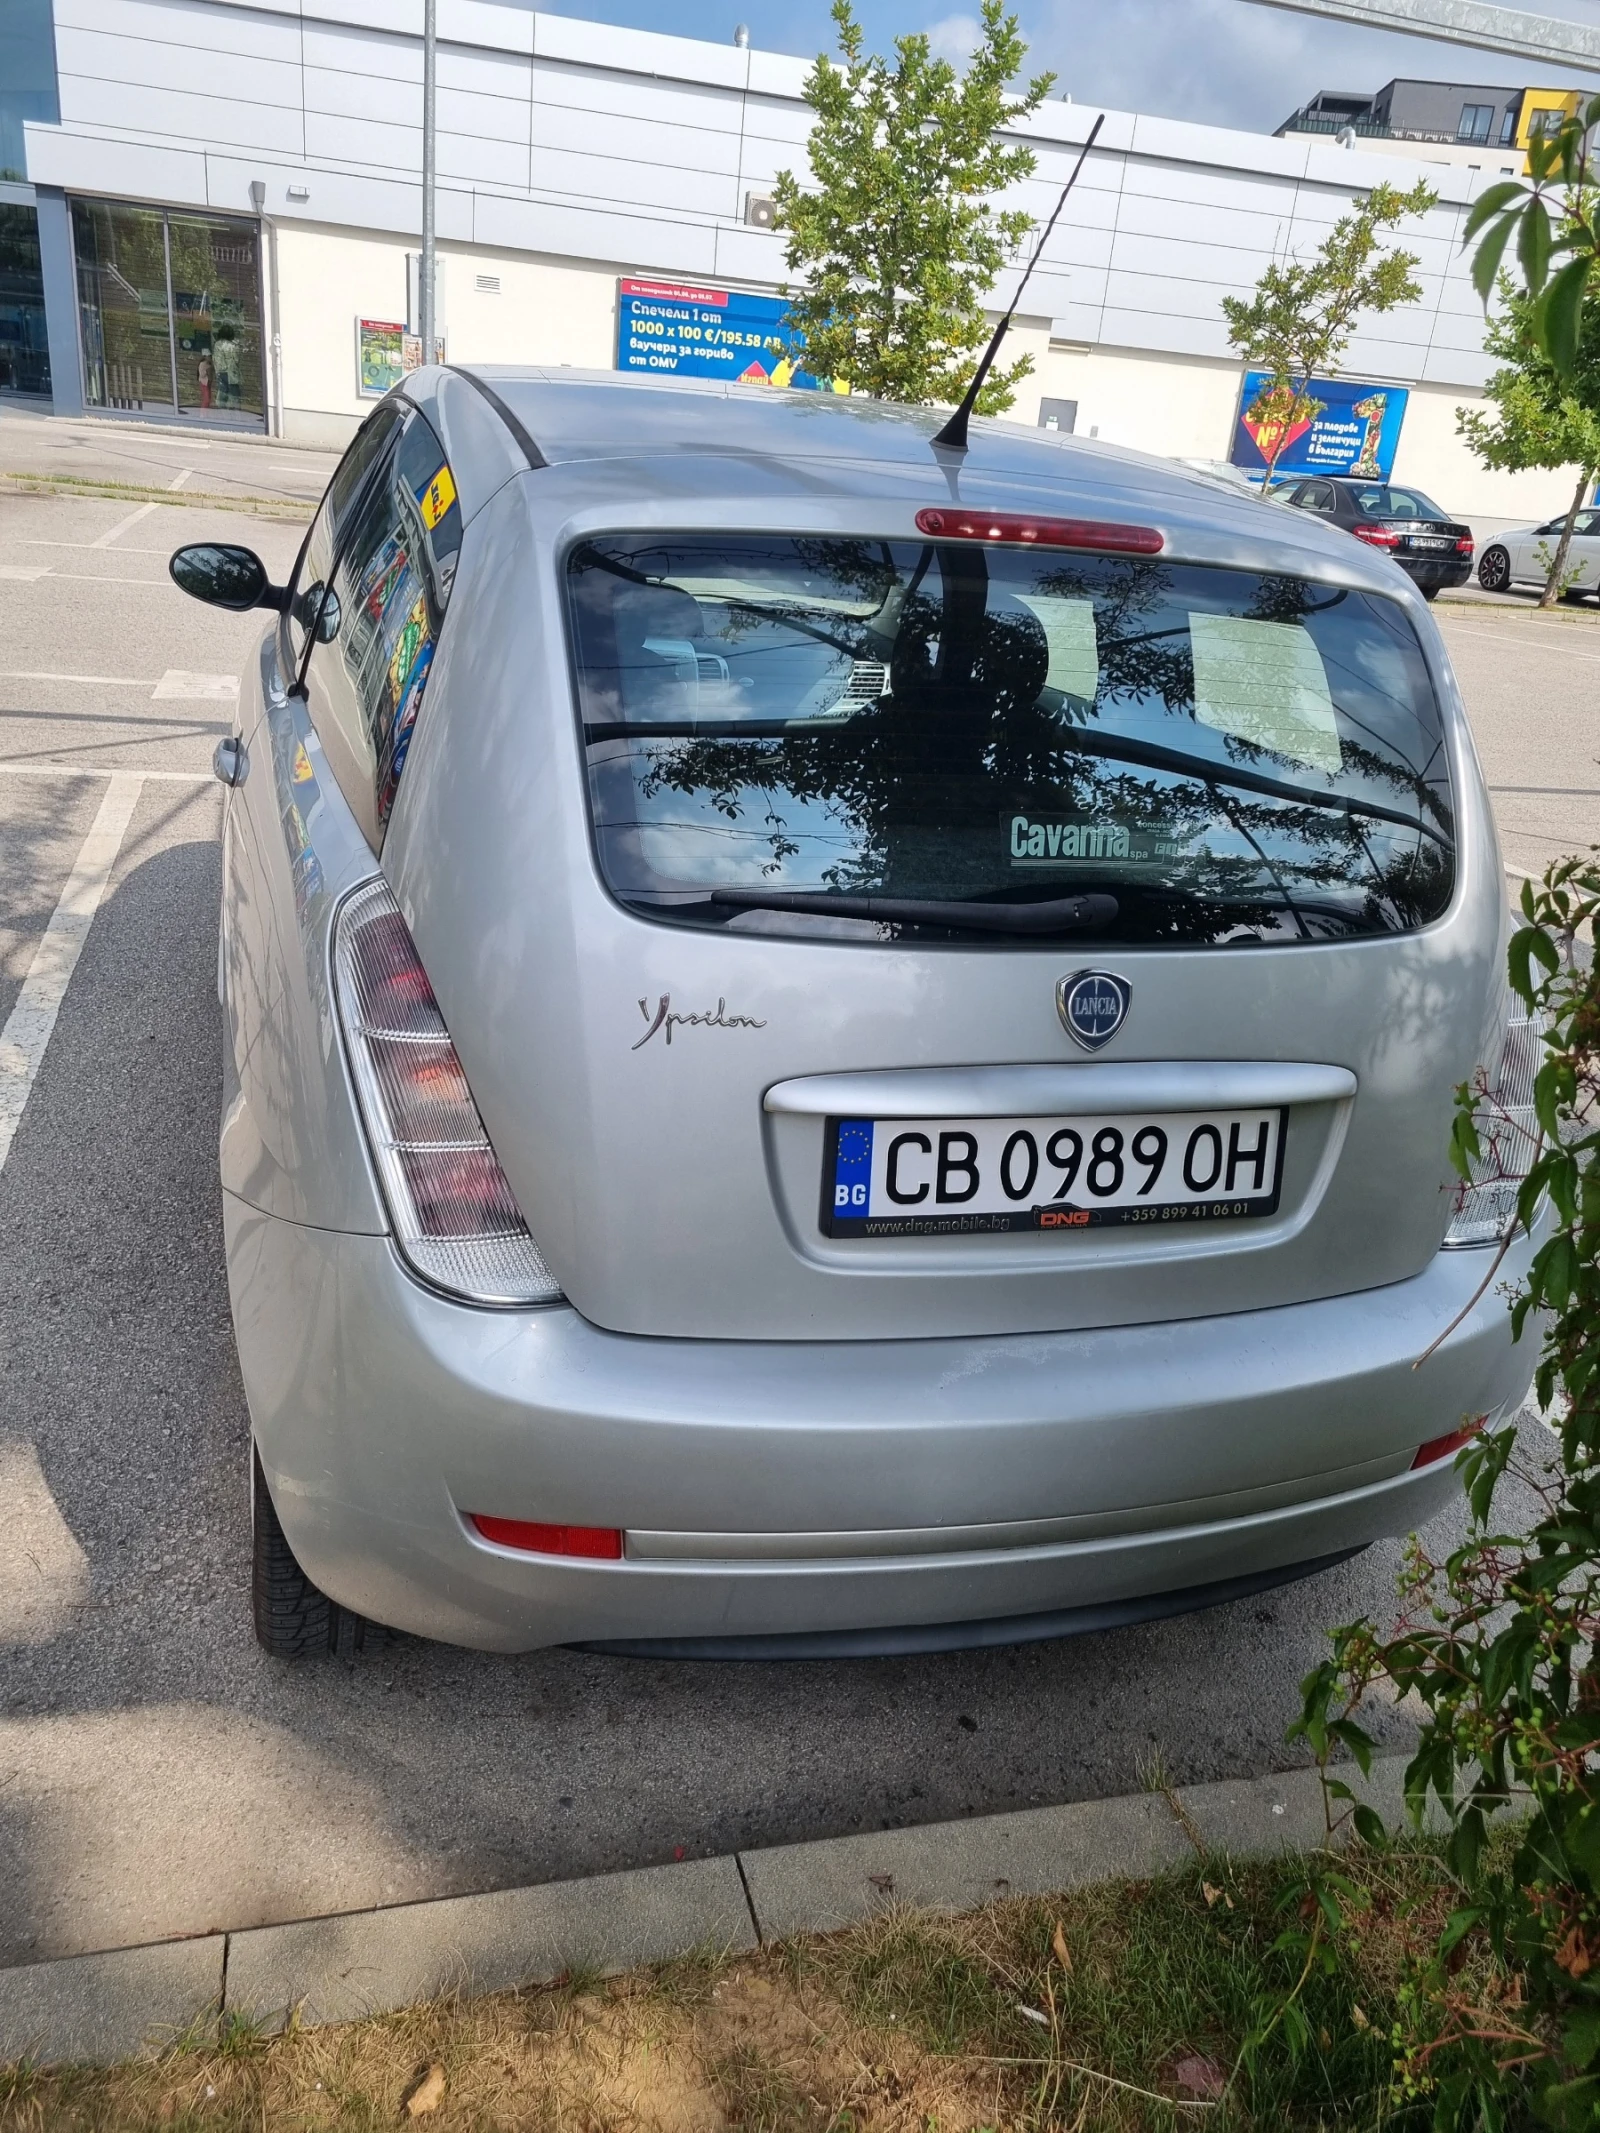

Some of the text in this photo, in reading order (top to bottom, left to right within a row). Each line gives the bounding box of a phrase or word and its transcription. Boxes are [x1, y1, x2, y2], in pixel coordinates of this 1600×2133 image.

[631, 301, 722, 324] Спечели 1 от
[630, 320, 665, 336] 1000
[678, 325, 702, 340] 100
[704, 328, 761, 348] €/195.58
[629, 337, 734, 360] ваучера за гориво
[629, 356, 678, 369] от OMV
[1312, 421, 1358, 434] за плодове
[1311, 433, 1361, 447] и зеленчуци
[1308, 443, 1355, 459] в България
[1010, 816, 1131, 858] Cavanna
[1130, 849, 1148, 860] spa
[1074, 996, 1118, 1015] LANCIA
[631, 992, 768, 1050] Ypsilon
[885, 1121, 1269, 1204] CB 0989 OH
[835, 1183, 866, 1206] BG
[1040, 1211, 1090, 1225] DNG
[1121, 1202, 1248, 1221] +359 899 41 06 01
